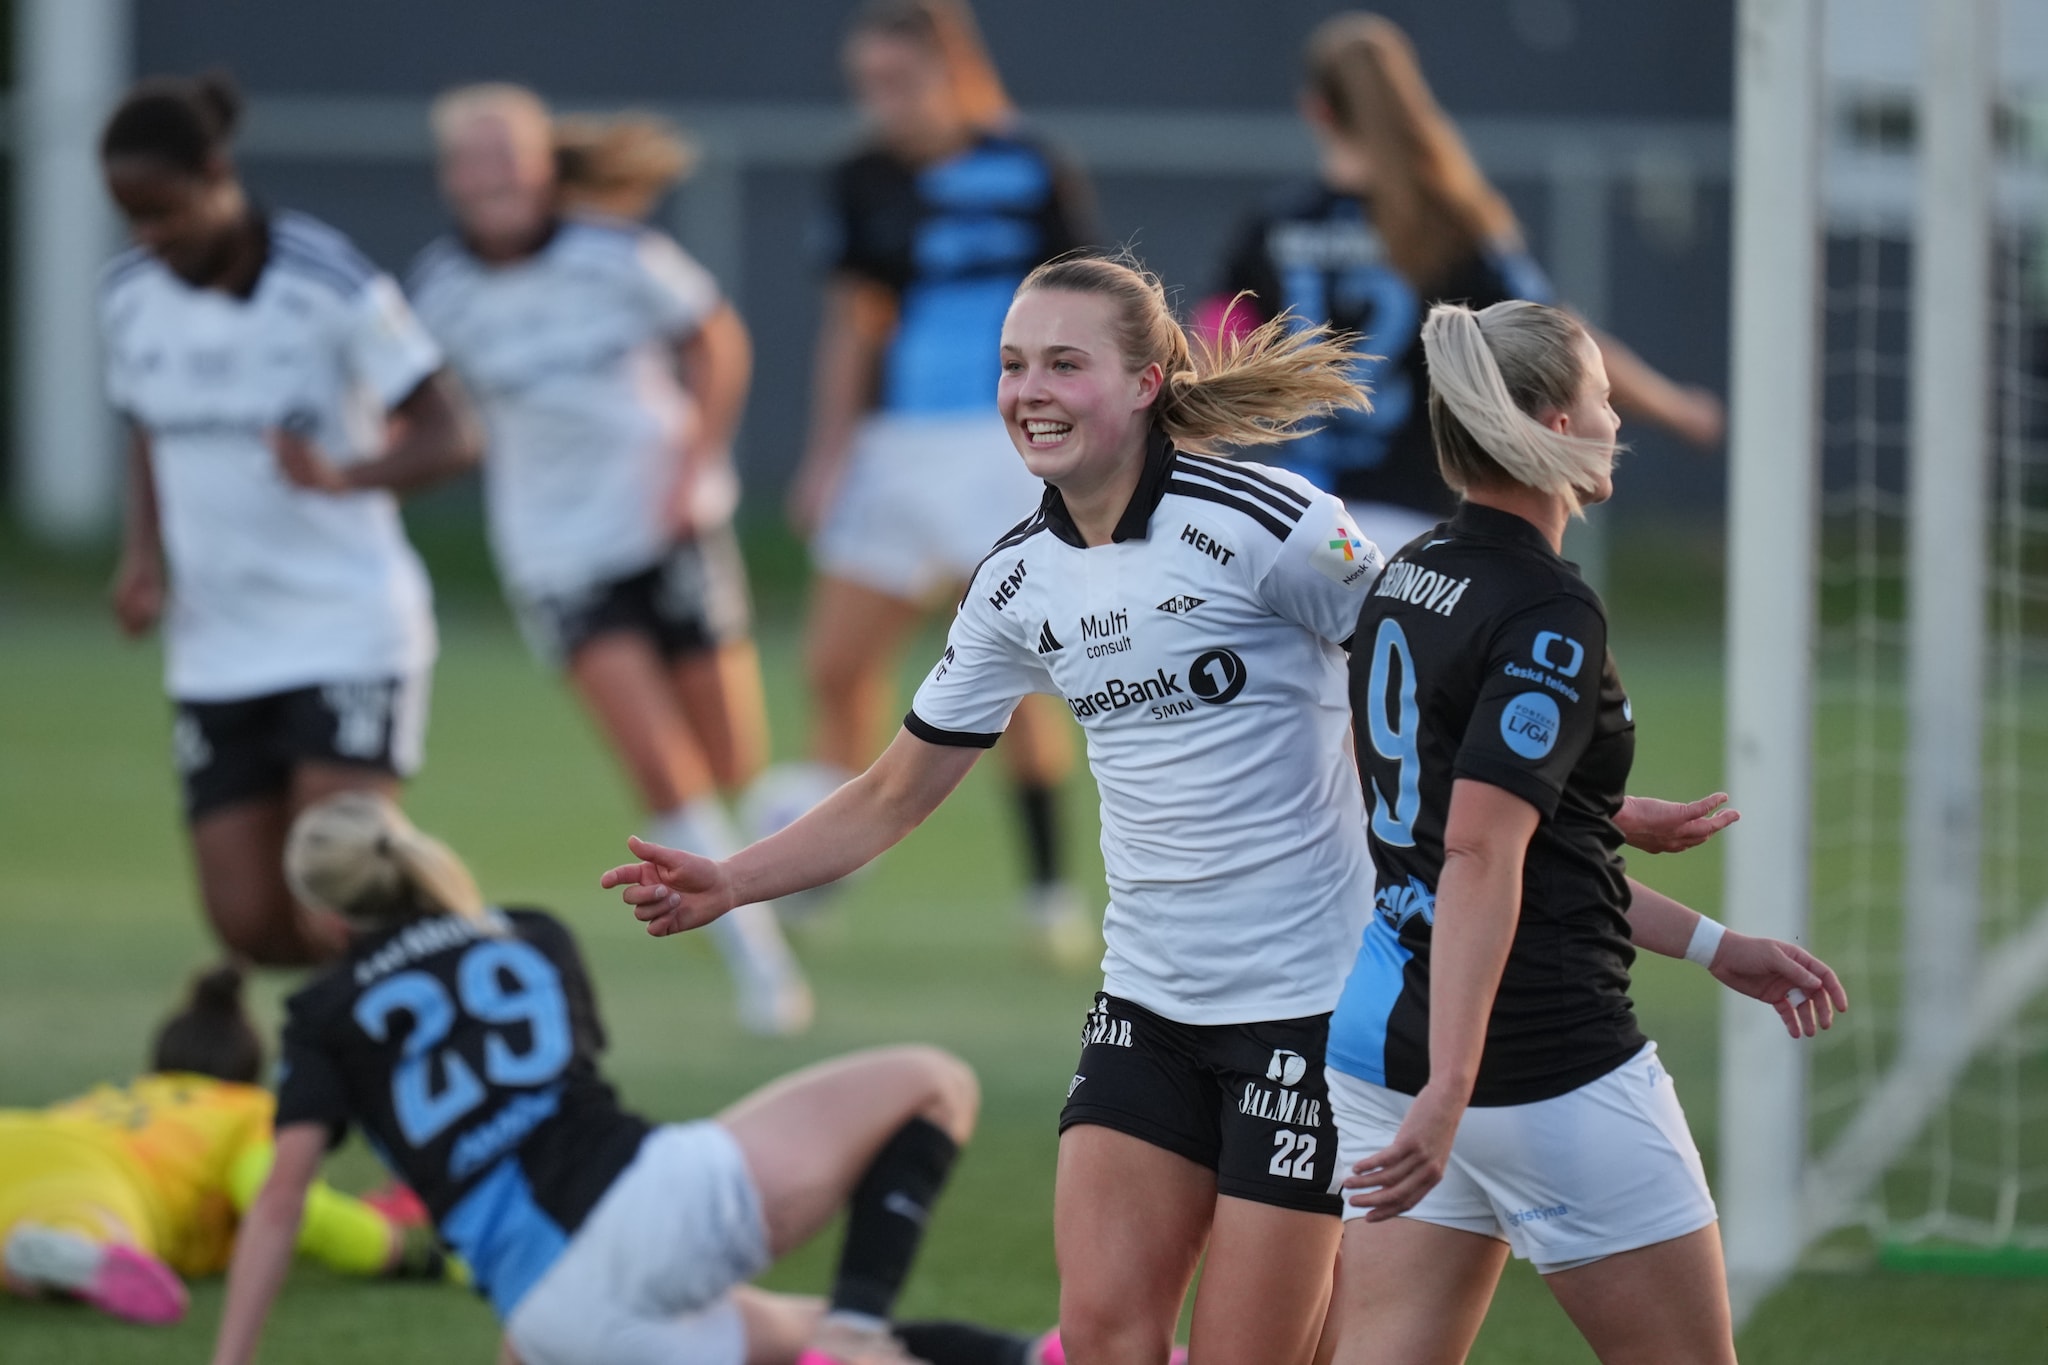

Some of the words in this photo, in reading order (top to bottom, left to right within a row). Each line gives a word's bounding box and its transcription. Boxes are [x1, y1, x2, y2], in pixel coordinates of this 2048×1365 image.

[1180, 523, 1236, 567] HENT
[988, 558, 1028, 612] HENT
[1341, 564, 1369, 587] Norsk
[1080, 607, 1129, 642] Multi
[1086, 635, 1132, 660] consult
[1068, 668, 1185, 723] pareBank
[1151, 699, 1195, 721] SMN
[1367, 618, 1421, 848] 9
[353, 940, 575, 1151] 29
[1268, 1129, 1317, 1180] 22
